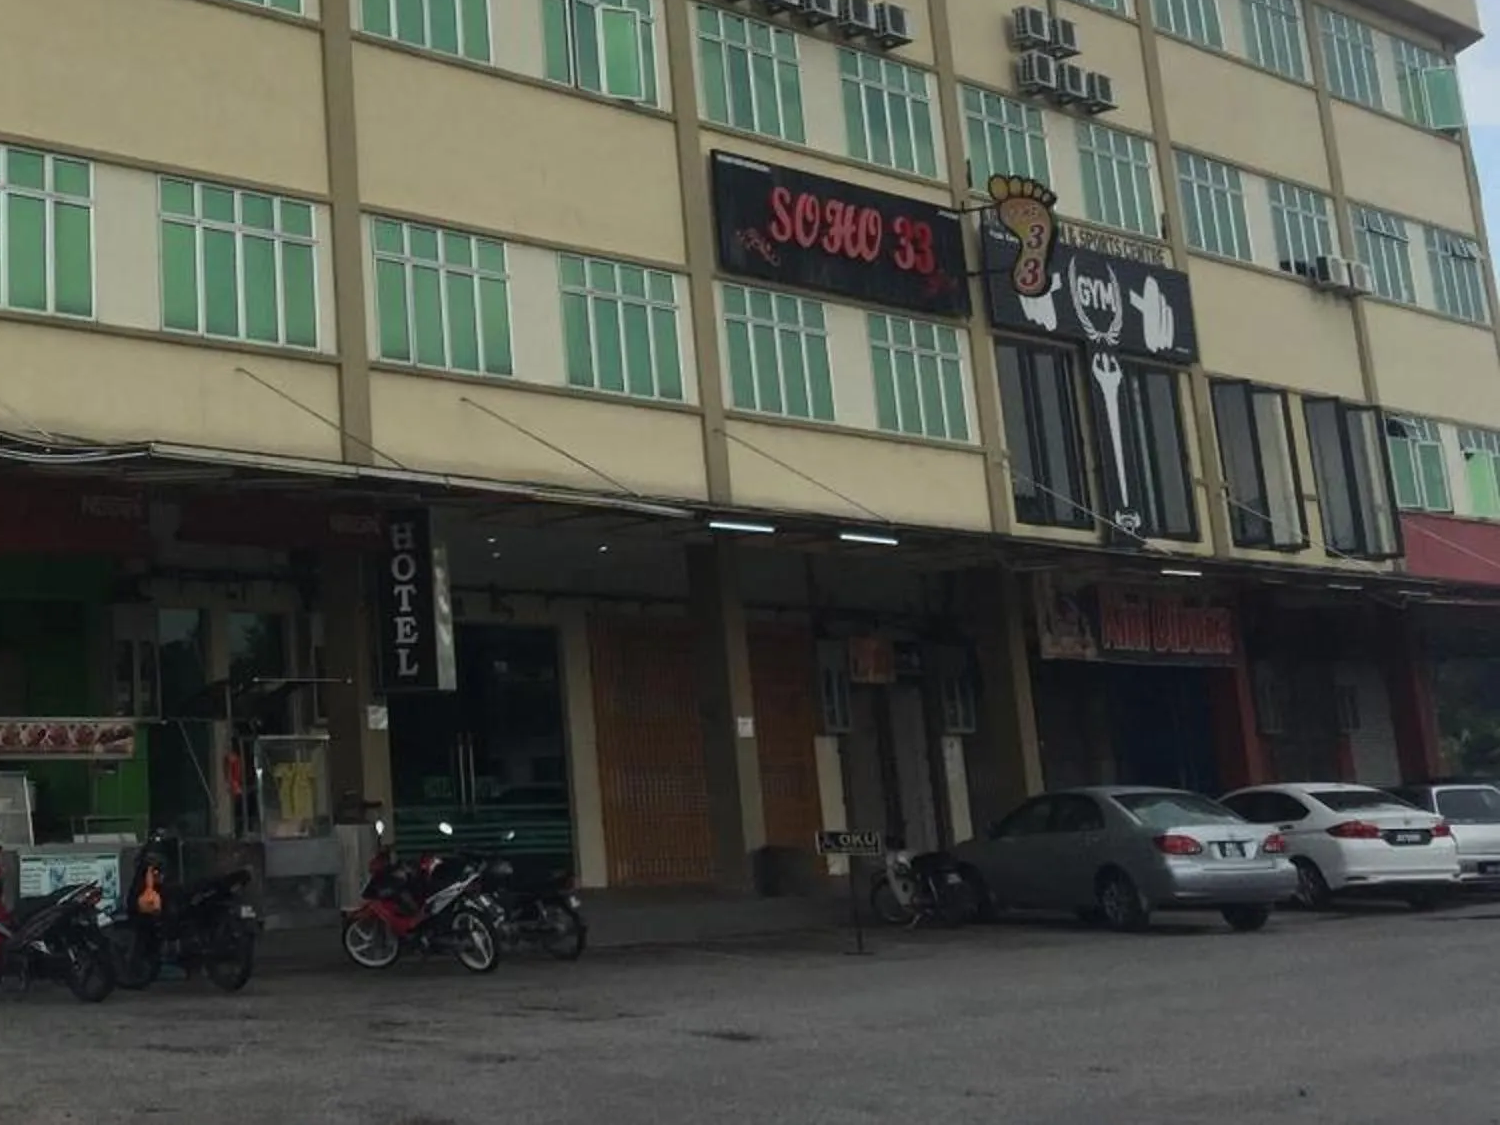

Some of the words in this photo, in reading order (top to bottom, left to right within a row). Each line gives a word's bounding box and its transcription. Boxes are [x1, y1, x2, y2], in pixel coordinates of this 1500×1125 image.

[769, 185, 883, 263] SOHO
[892, 216, 936, 275] 33
[1078, 275, 1118, 313] GYM
[390, 522, 419, 677] HOTEL
